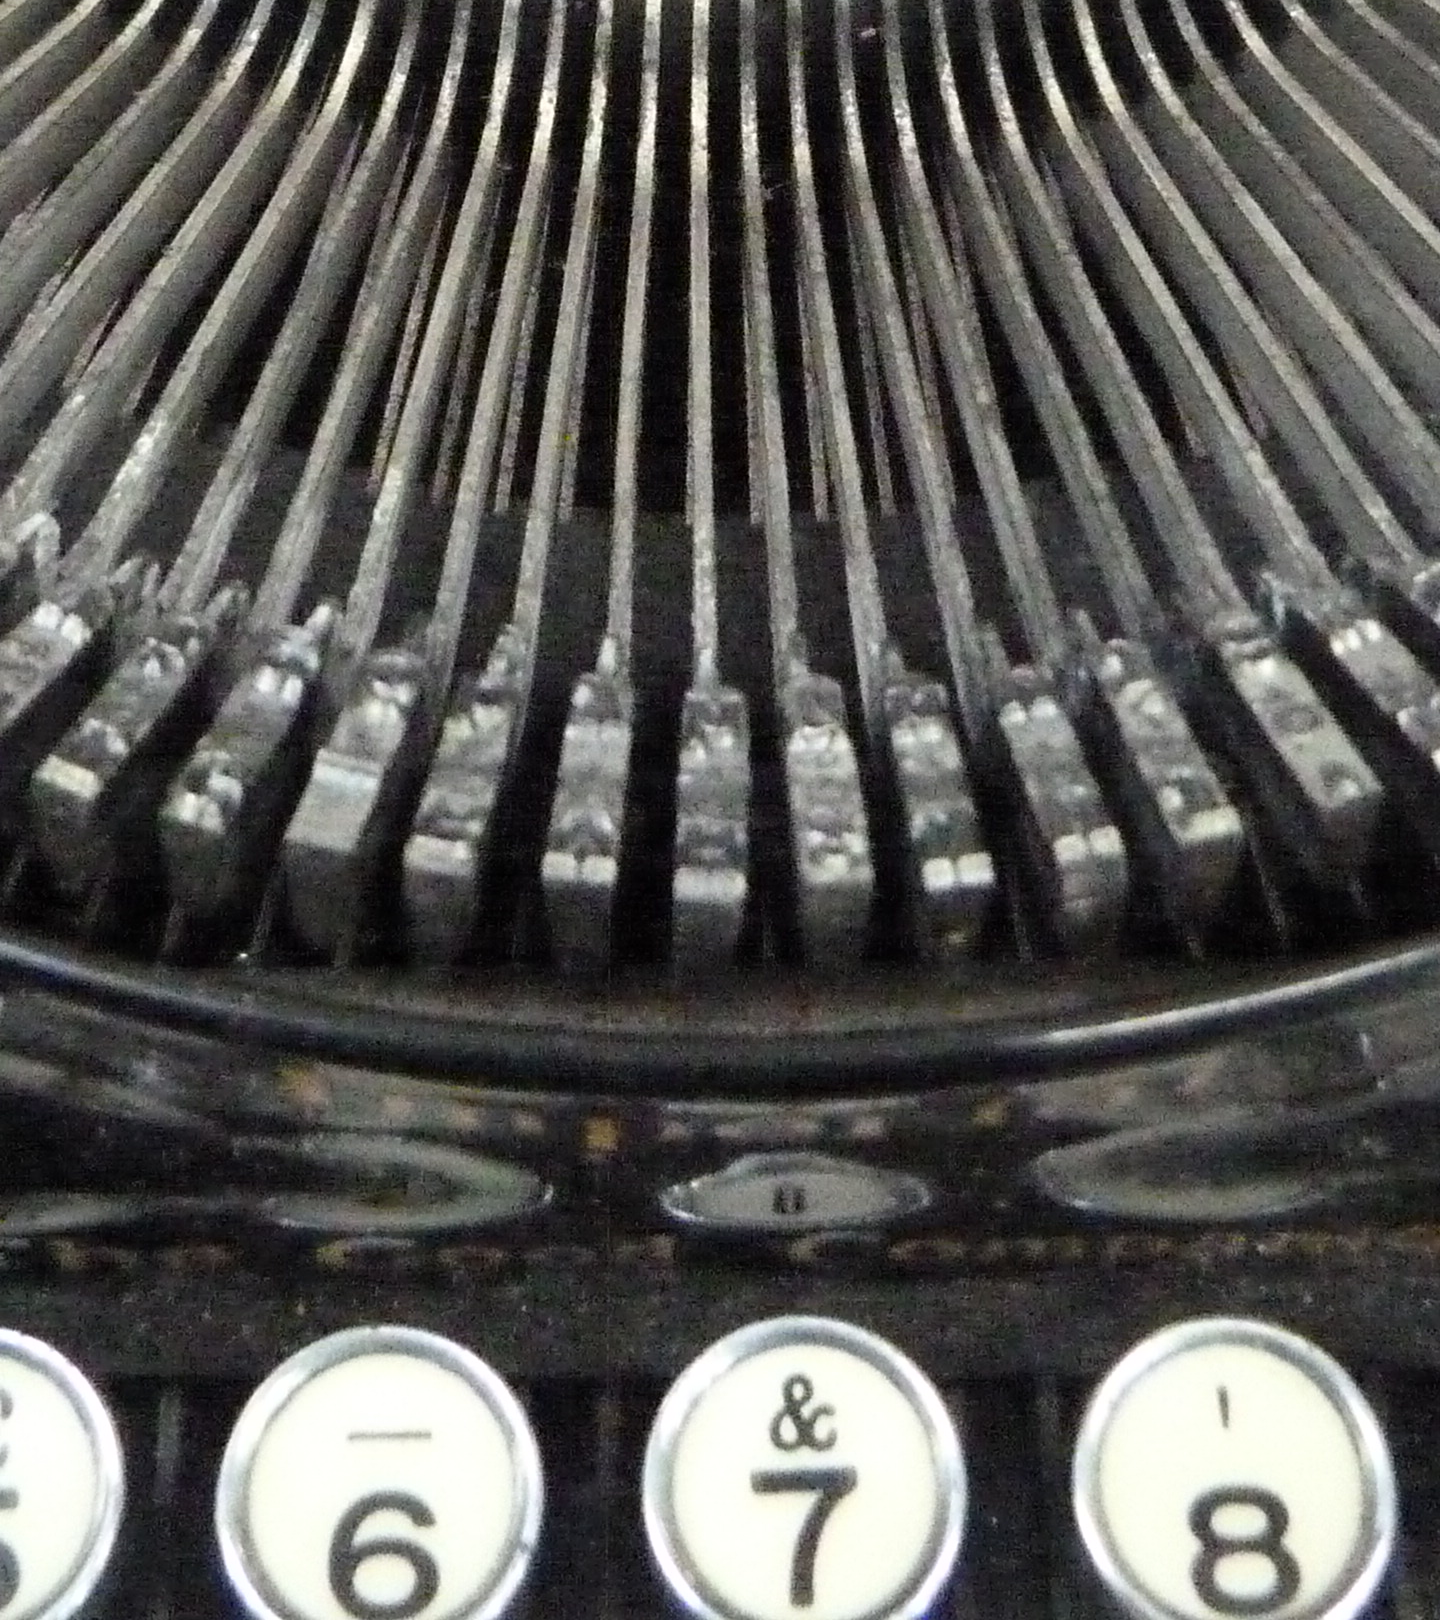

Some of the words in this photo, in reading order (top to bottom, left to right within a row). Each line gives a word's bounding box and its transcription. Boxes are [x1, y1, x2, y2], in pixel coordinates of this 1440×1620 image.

[769, 1373, 837, 1452] &
[328, 1490, 440, 1620] 6
[750, 1467, 858, 1606] 7
[1186, 1485, 1301, 1615] 8
